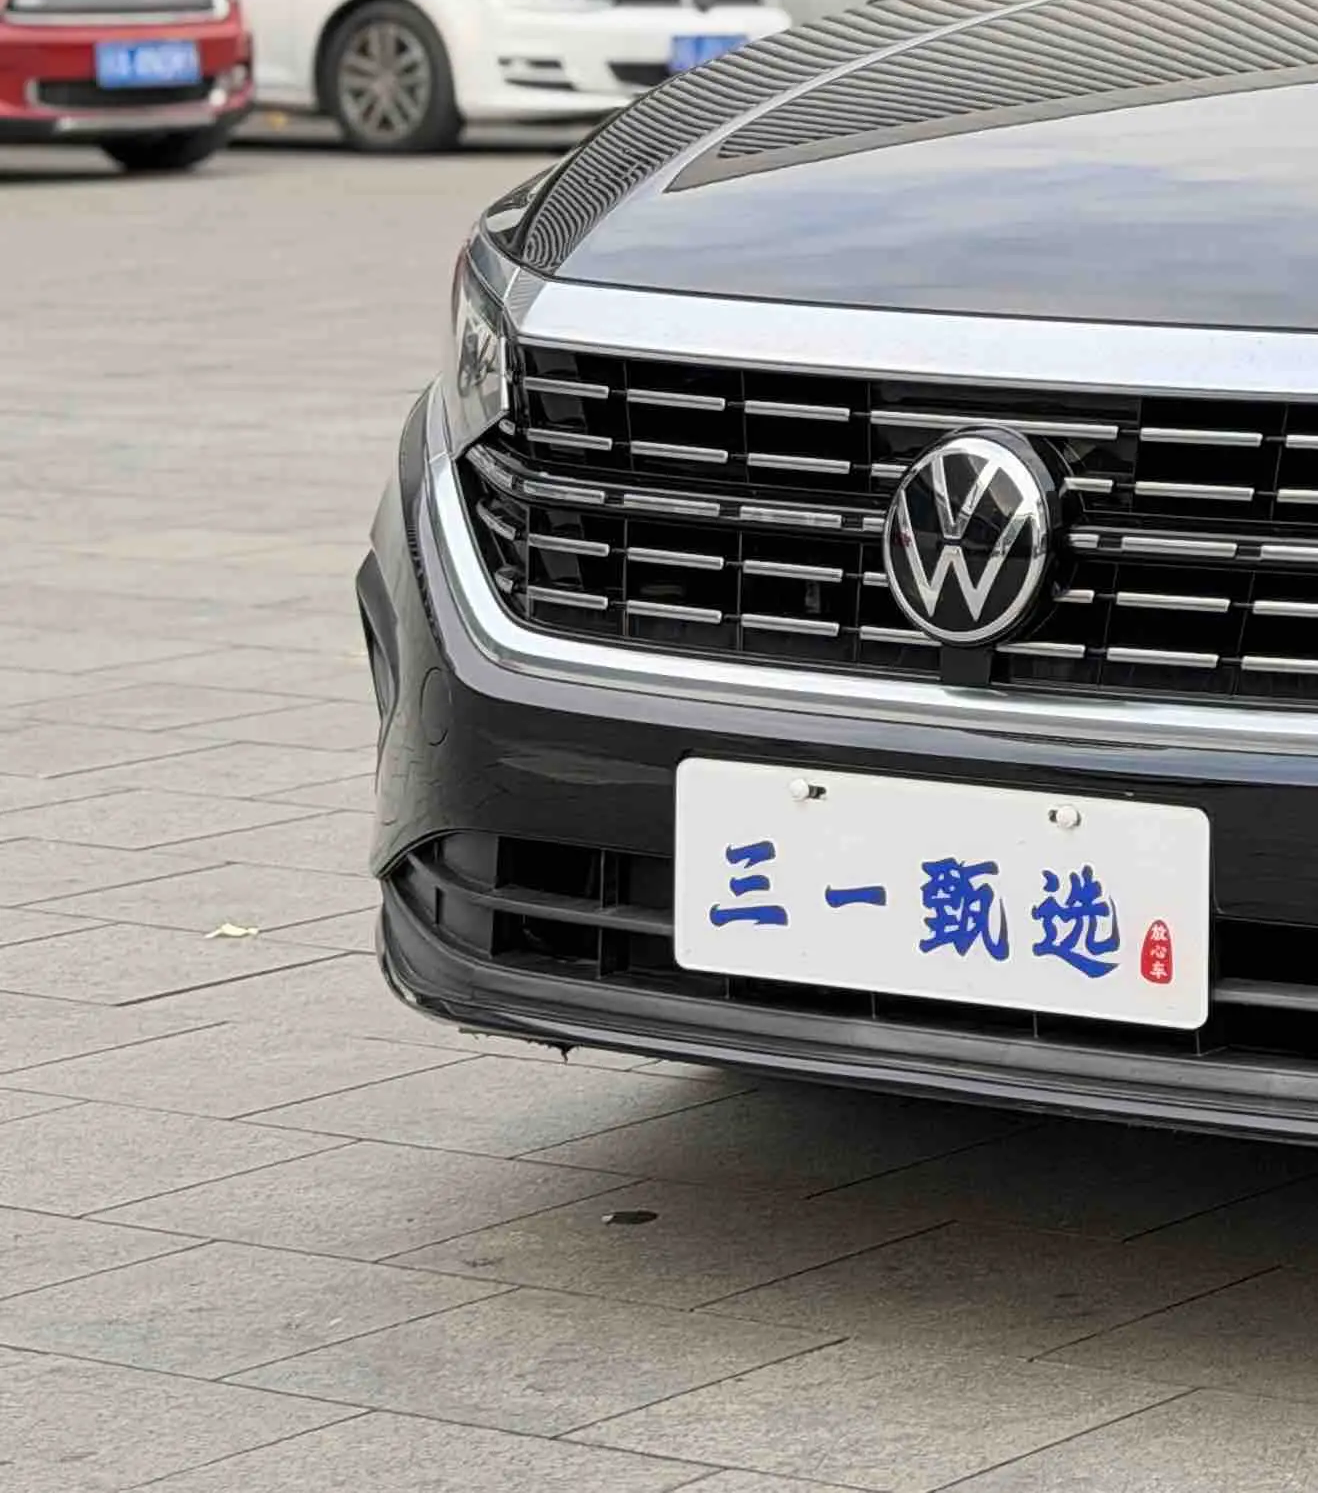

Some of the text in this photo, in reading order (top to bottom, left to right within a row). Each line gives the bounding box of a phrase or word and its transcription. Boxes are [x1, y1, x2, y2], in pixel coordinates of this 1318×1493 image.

[897, 445, 1036, 622] VW
[709, 840, 1120, 978] 三一甄选
[1149, 923, 1169, 980] 放心车
